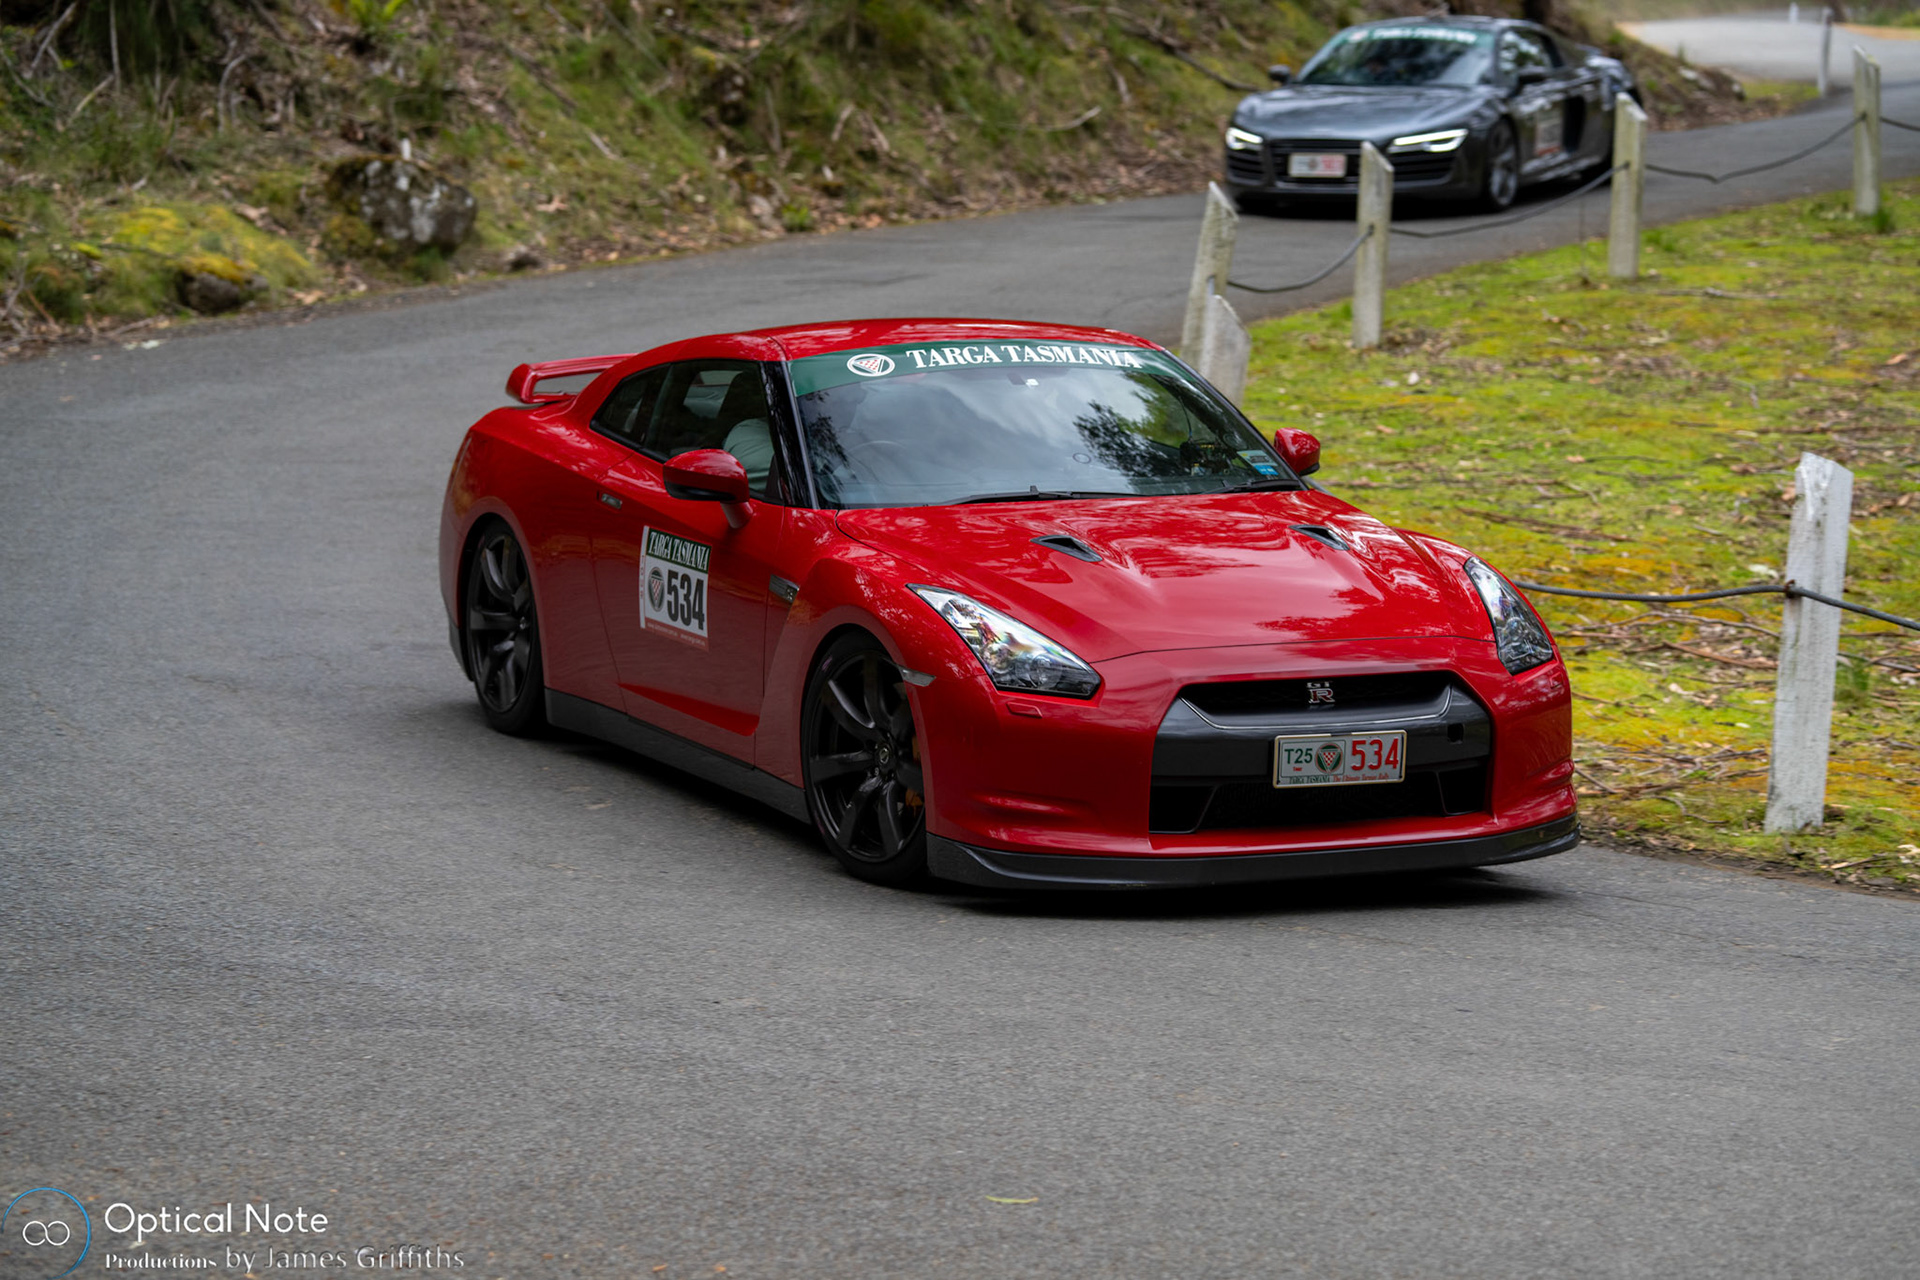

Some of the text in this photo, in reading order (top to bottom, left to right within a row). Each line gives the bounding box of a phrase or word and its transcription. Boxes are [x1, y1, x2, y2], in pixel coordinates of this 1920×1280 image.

[906, 345, 1142, 369] TARGA TASMANIA
[648, 531, 709, 570] TARGA TASMANIA
[667, 569, 705, 630] 534
[1284, 748, 1313, 764] T25
[1351, 738, 1399, 771] 534
